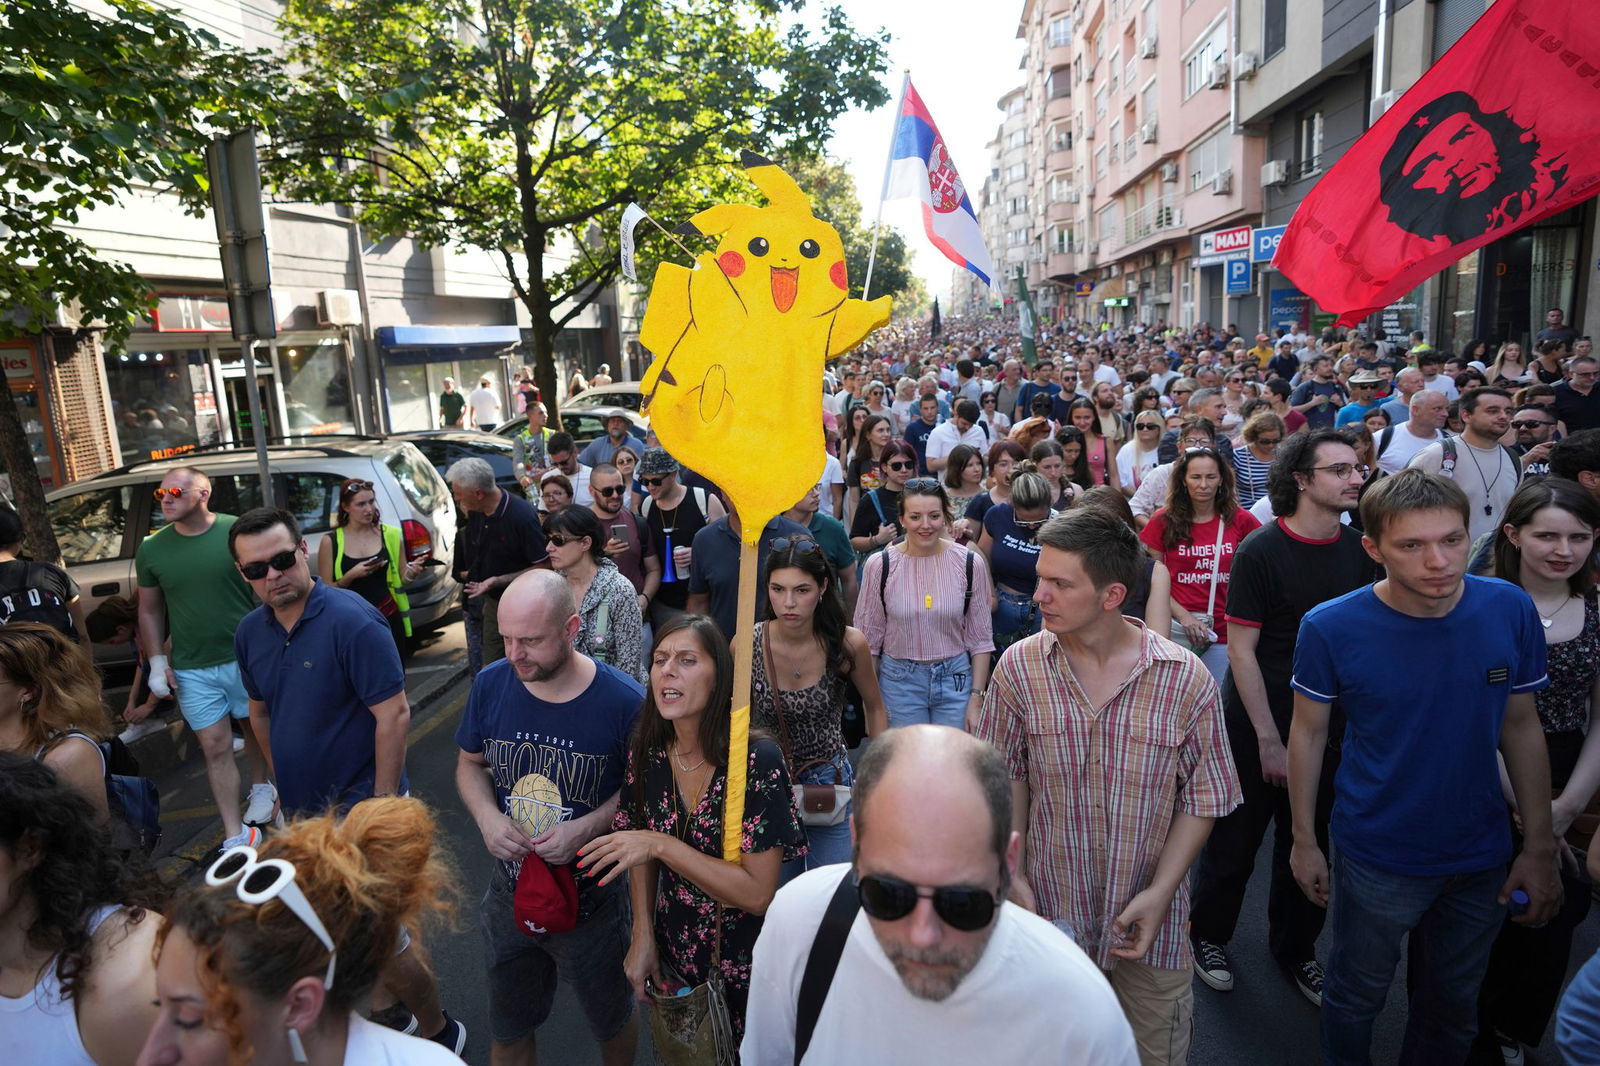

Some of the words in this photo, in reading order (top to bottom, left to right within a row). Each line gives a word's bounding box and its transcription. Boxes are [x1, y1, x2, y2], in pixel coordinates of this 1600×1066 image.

[1216, 230, 1249, 250] MAXI
[1232, 262, 1246, 279] P
[1272, 306, 1304, 316] pepco
[0, 356, 28, 370] ies
[1178, 543, 1233, 557] STUDENTS
[1195, 558, 1215, 570] ARE
[516, 732, 540, 741] EST
